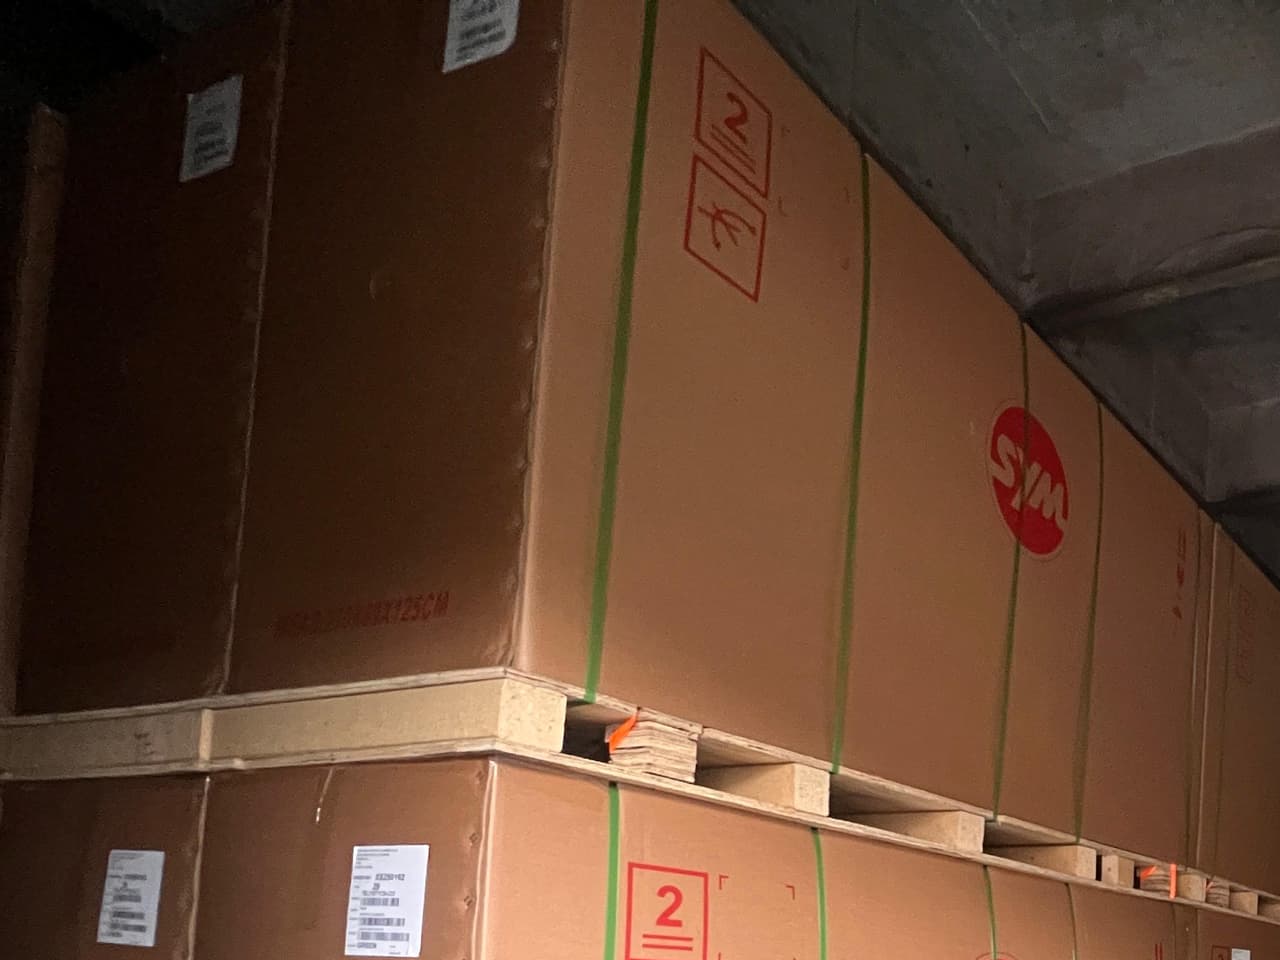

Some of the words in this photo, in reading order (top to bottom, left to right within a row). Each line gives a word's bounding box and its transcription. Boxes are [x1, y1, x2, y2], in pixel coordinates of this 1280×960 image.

[724, 92, 749, 145] 2
[992, 433, 1068, 531] SYM
[656, 885, 683, 928] 2
